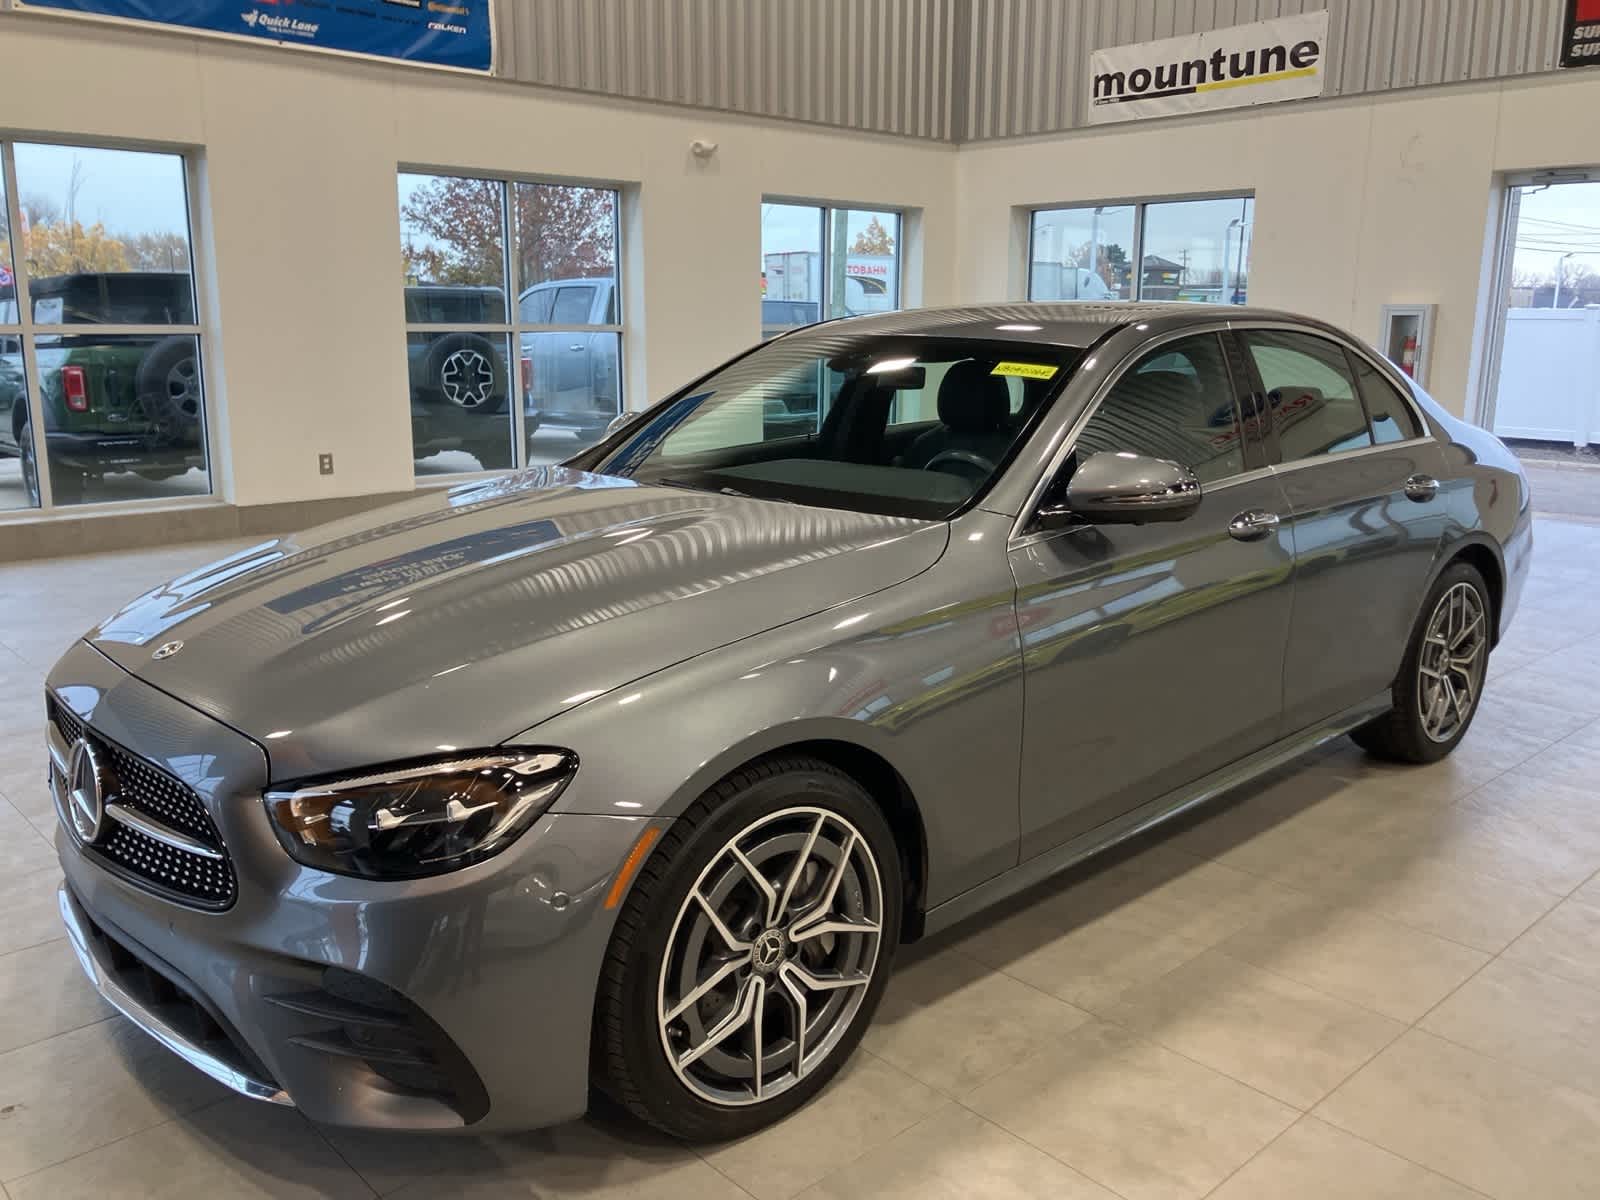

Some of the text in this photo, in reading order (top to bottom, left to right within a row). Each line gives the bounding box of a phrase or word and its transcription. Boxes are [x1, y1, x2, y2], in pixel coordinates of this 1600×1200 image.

[259, 14, 290, 28] Quick
[291, 19, 319, 33] Lane
[1093, 40, 1320, 98] mountune
